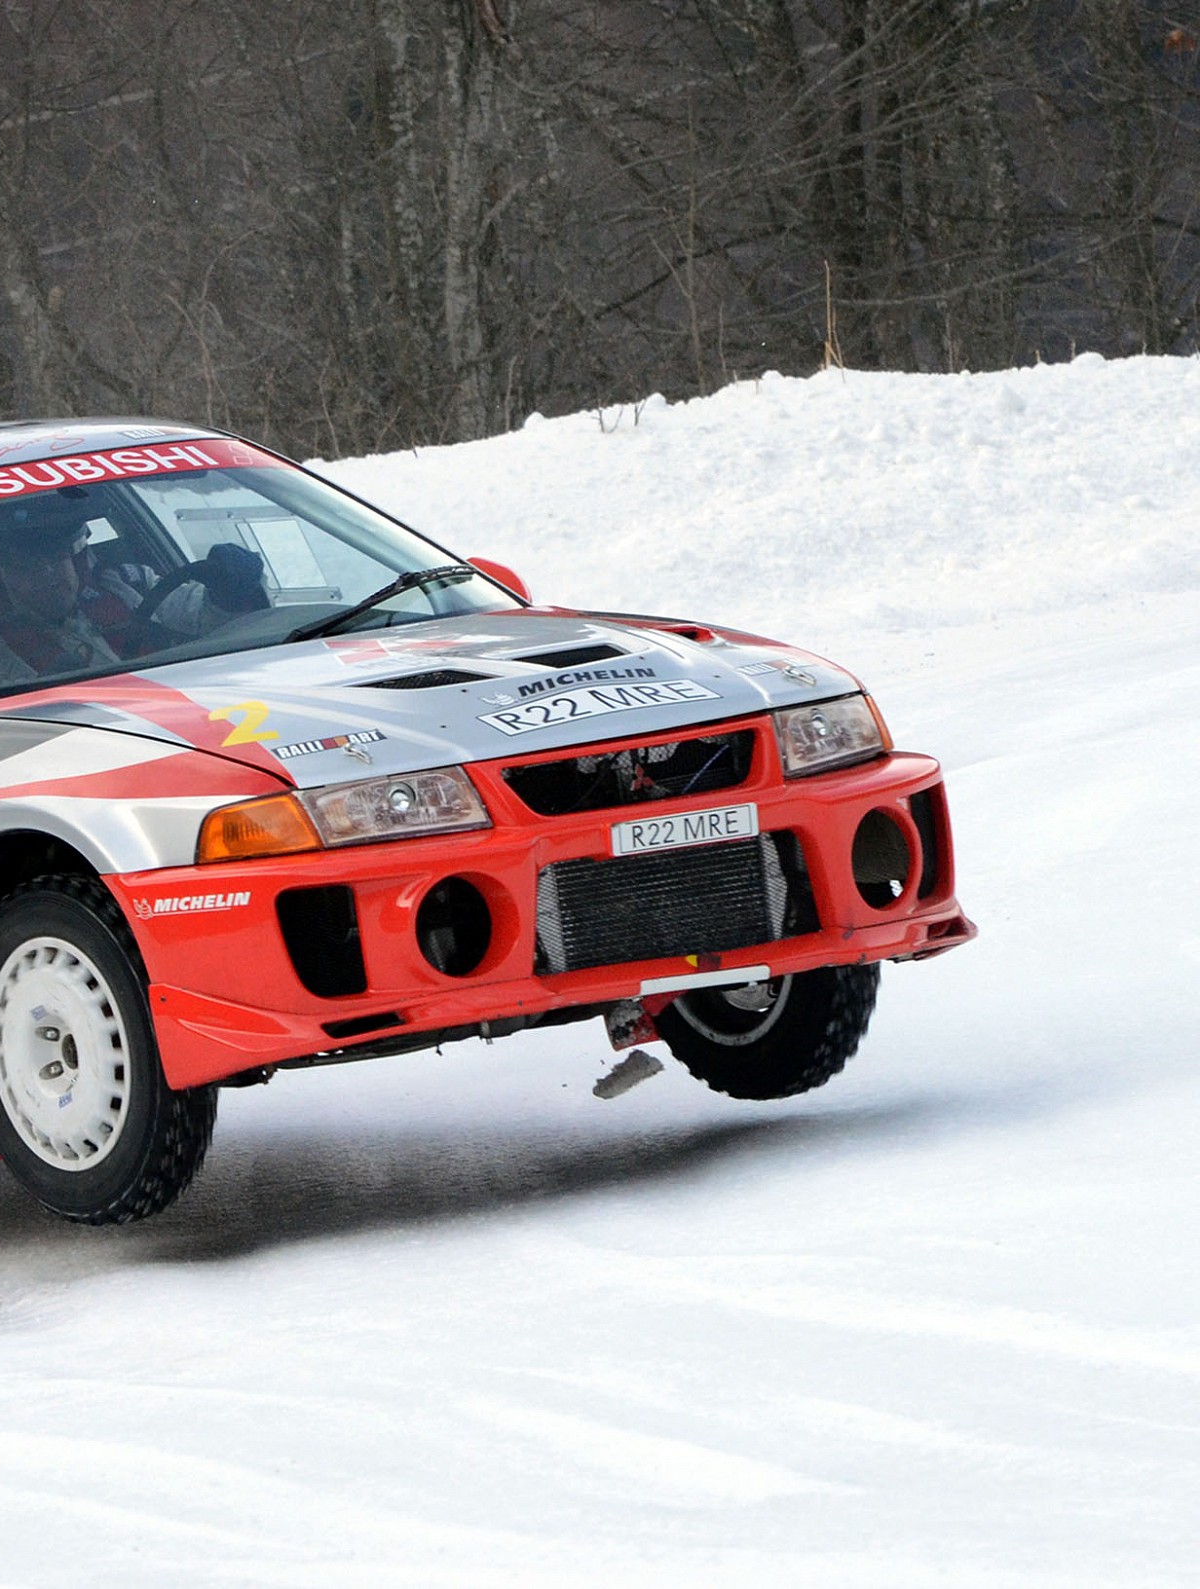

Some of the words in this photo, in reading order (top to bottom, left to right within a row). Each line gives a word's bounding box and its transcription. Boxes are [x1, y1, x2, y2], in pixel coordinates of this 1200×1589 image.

[518, 667, 657, 698] MICHELIN
[493, 697, 593, 731] R22
[596, 681, 708, 710] MRE
[208, 700, 280, 748] 2
[277, 740, 324, 760] RALLI
[347, 729, 382, 746] ART
[631, 820, 676, 848] R22
[684, 811, 740, 840] MRE
[153, 892, 252, 913] MICHELIN
